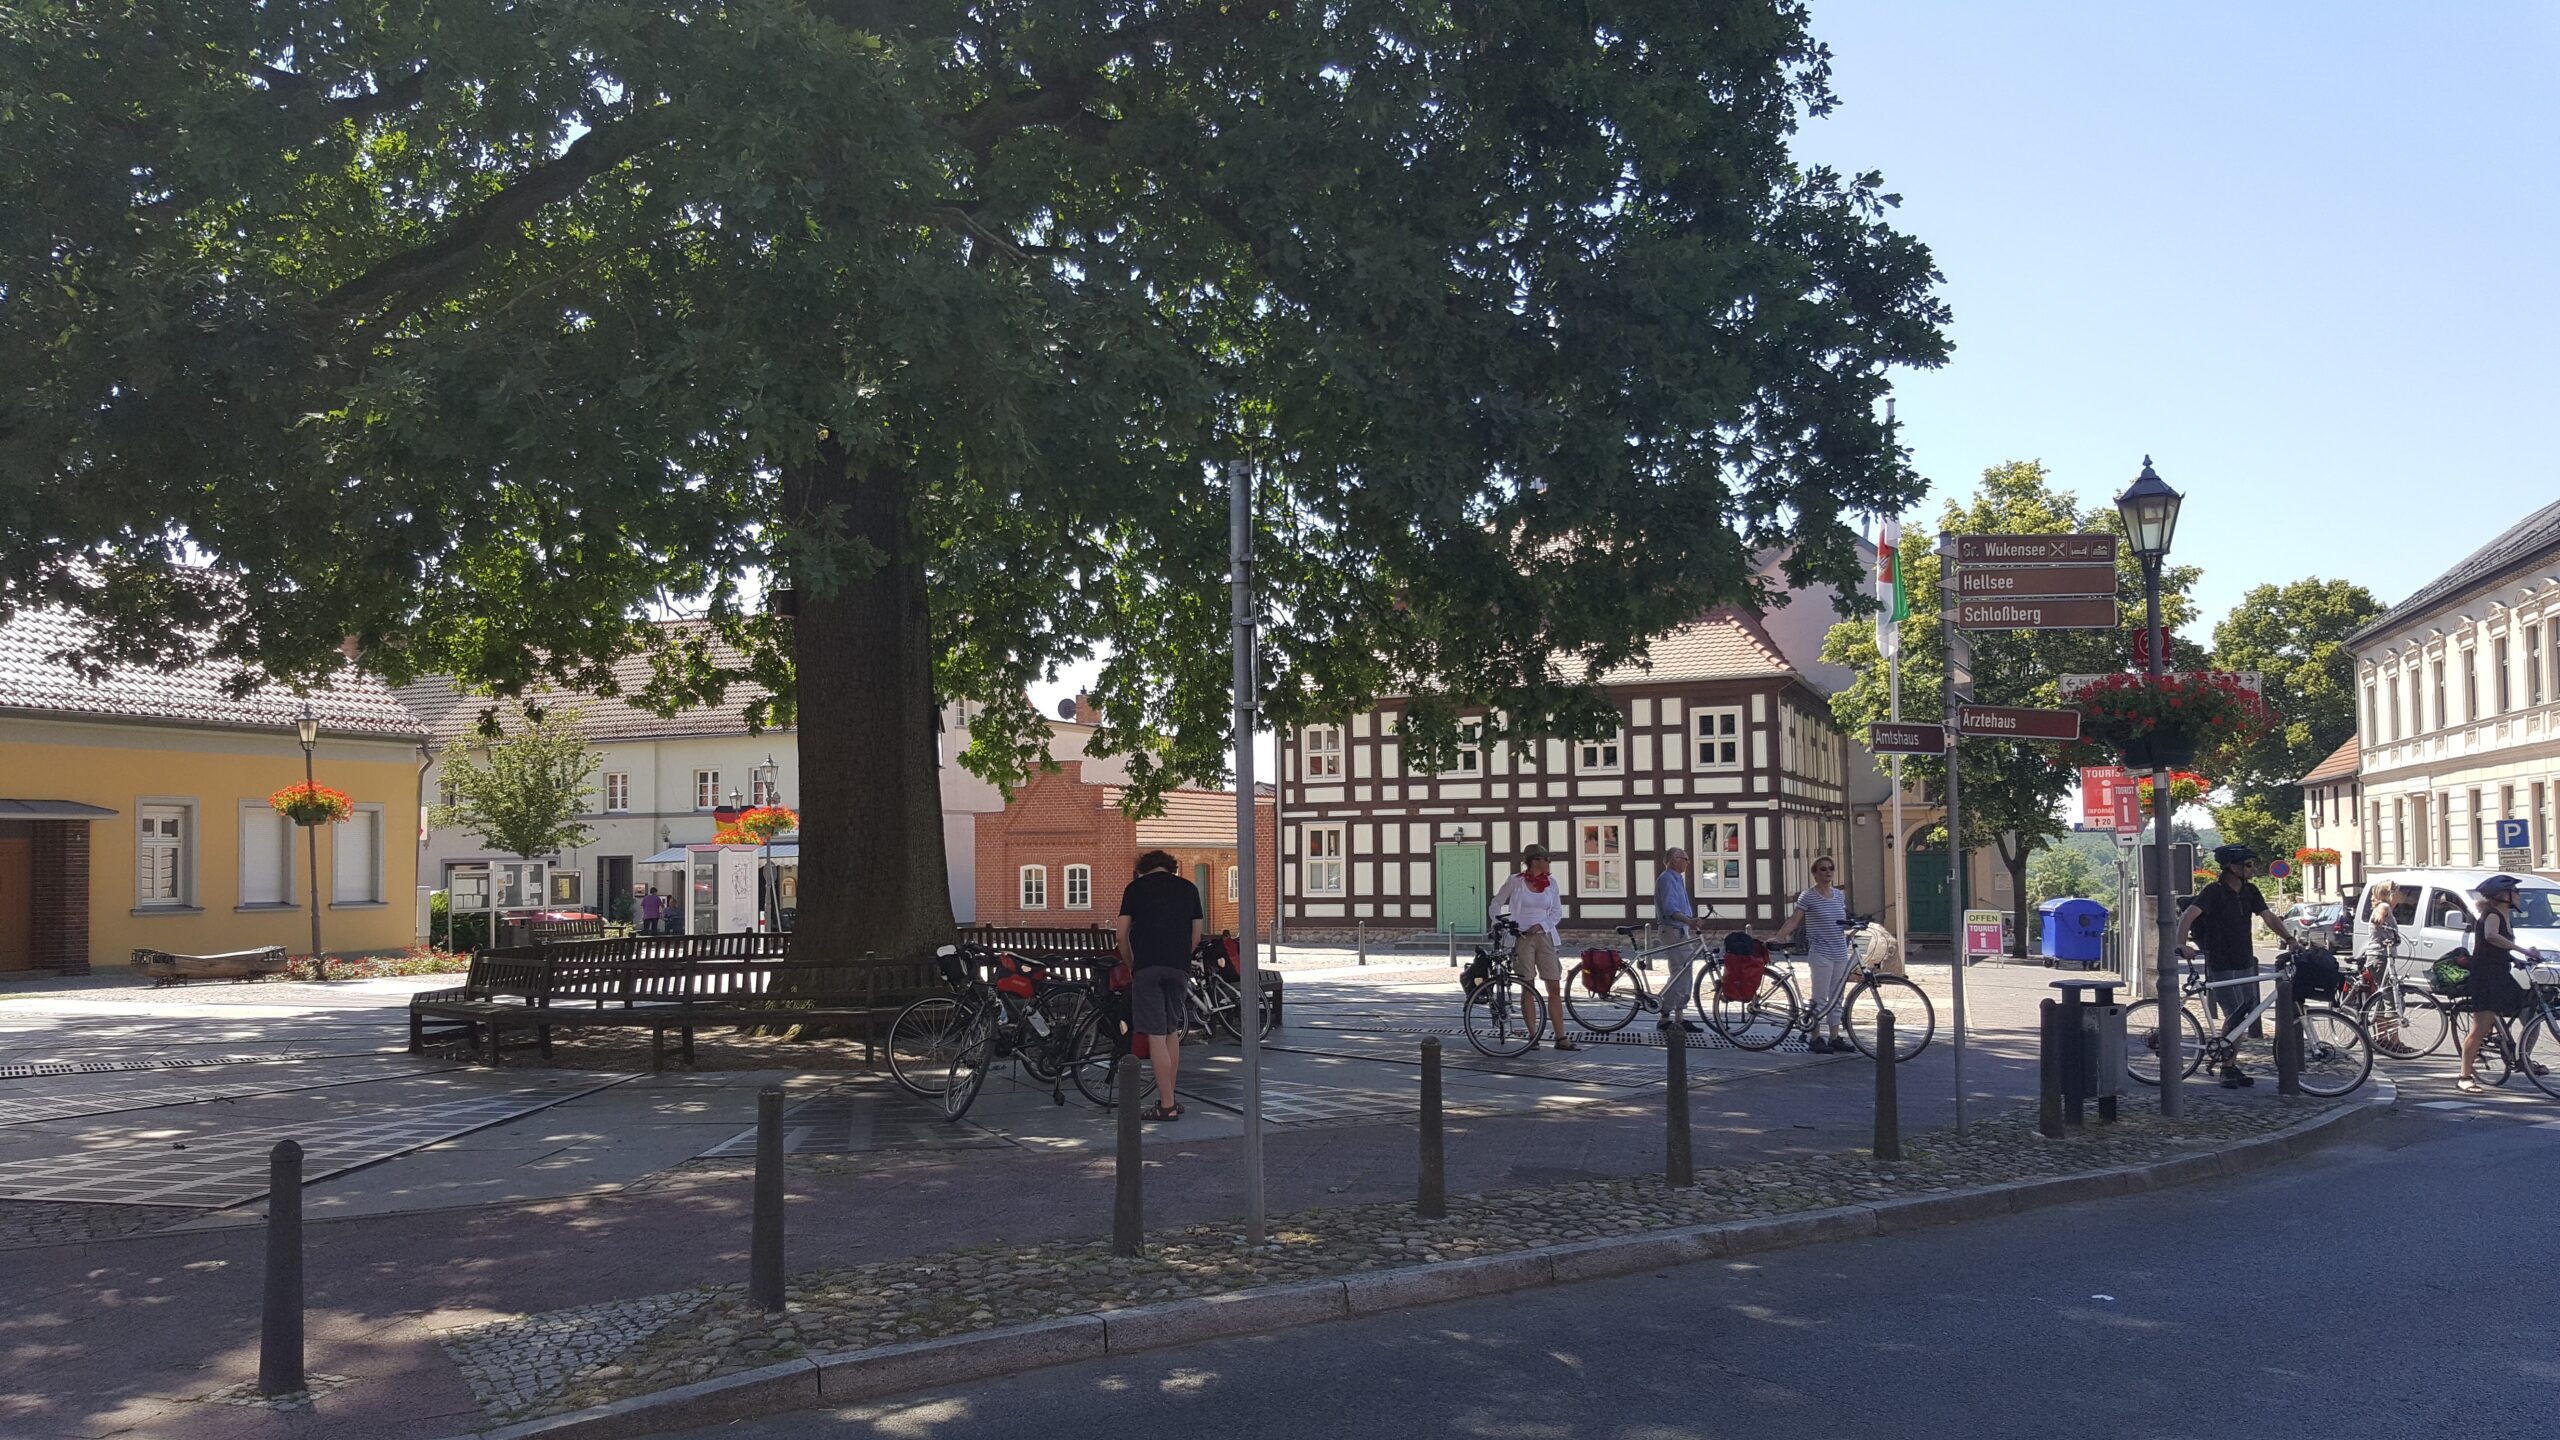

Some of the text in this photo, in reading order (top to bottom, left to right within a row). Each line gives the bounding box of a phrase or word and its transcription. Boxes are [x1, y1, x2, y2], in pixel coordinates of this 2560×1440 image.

[1985, 542, 2046, 557] Wukensee
[1963, 574, 2014, 590] Hellsee
[1964, 606, 2041, 625] Schloßberg
[1962, 708, 2017, 729] Ärztehaus
[1875, 729, 1920, 746] Amtshaus
[2115, 786, 2135, 794] TOURIST
[2503, 823, 2522, 845] P
[1968, 914, 1998, 922] OFFEN
